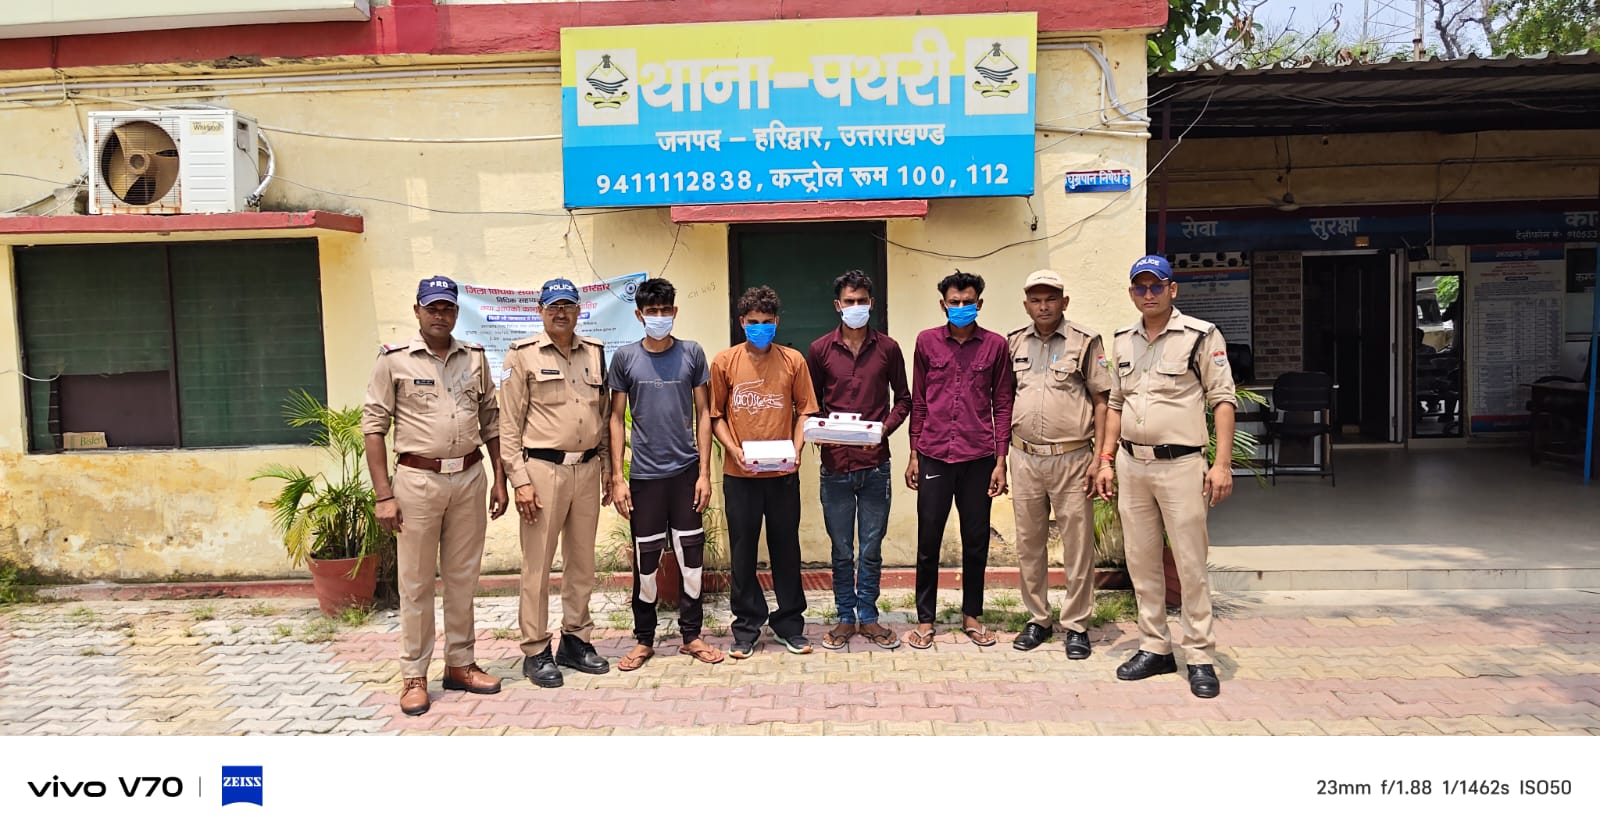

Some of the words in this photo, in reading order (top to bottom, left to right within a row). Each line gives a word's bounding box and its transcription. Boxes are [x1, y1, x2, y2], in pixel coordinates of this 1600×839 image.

[656, 128, 721, 153] जनपद
[753, 120, 831, 151] हरिद्वार,
[838, 123, 946, 147] उत्तराखण्ड
[597, 170, 763, 194] 9411112838,
[769, 161, 844, 194] कन्ट्रोल
[849, 166, 888, 188] रूम
[898, 165, 957, 188] 100,
[966, 163, 1010, 185] 112
[1180, 216, 1218, 240] सेवा
[1309, 217, 1360, 241] सुरक्षा
[1136, 258, 1160, 268] POLICE
[430, 280, 449, 288] PRD
[549, 284, 574, 292] POLICE
